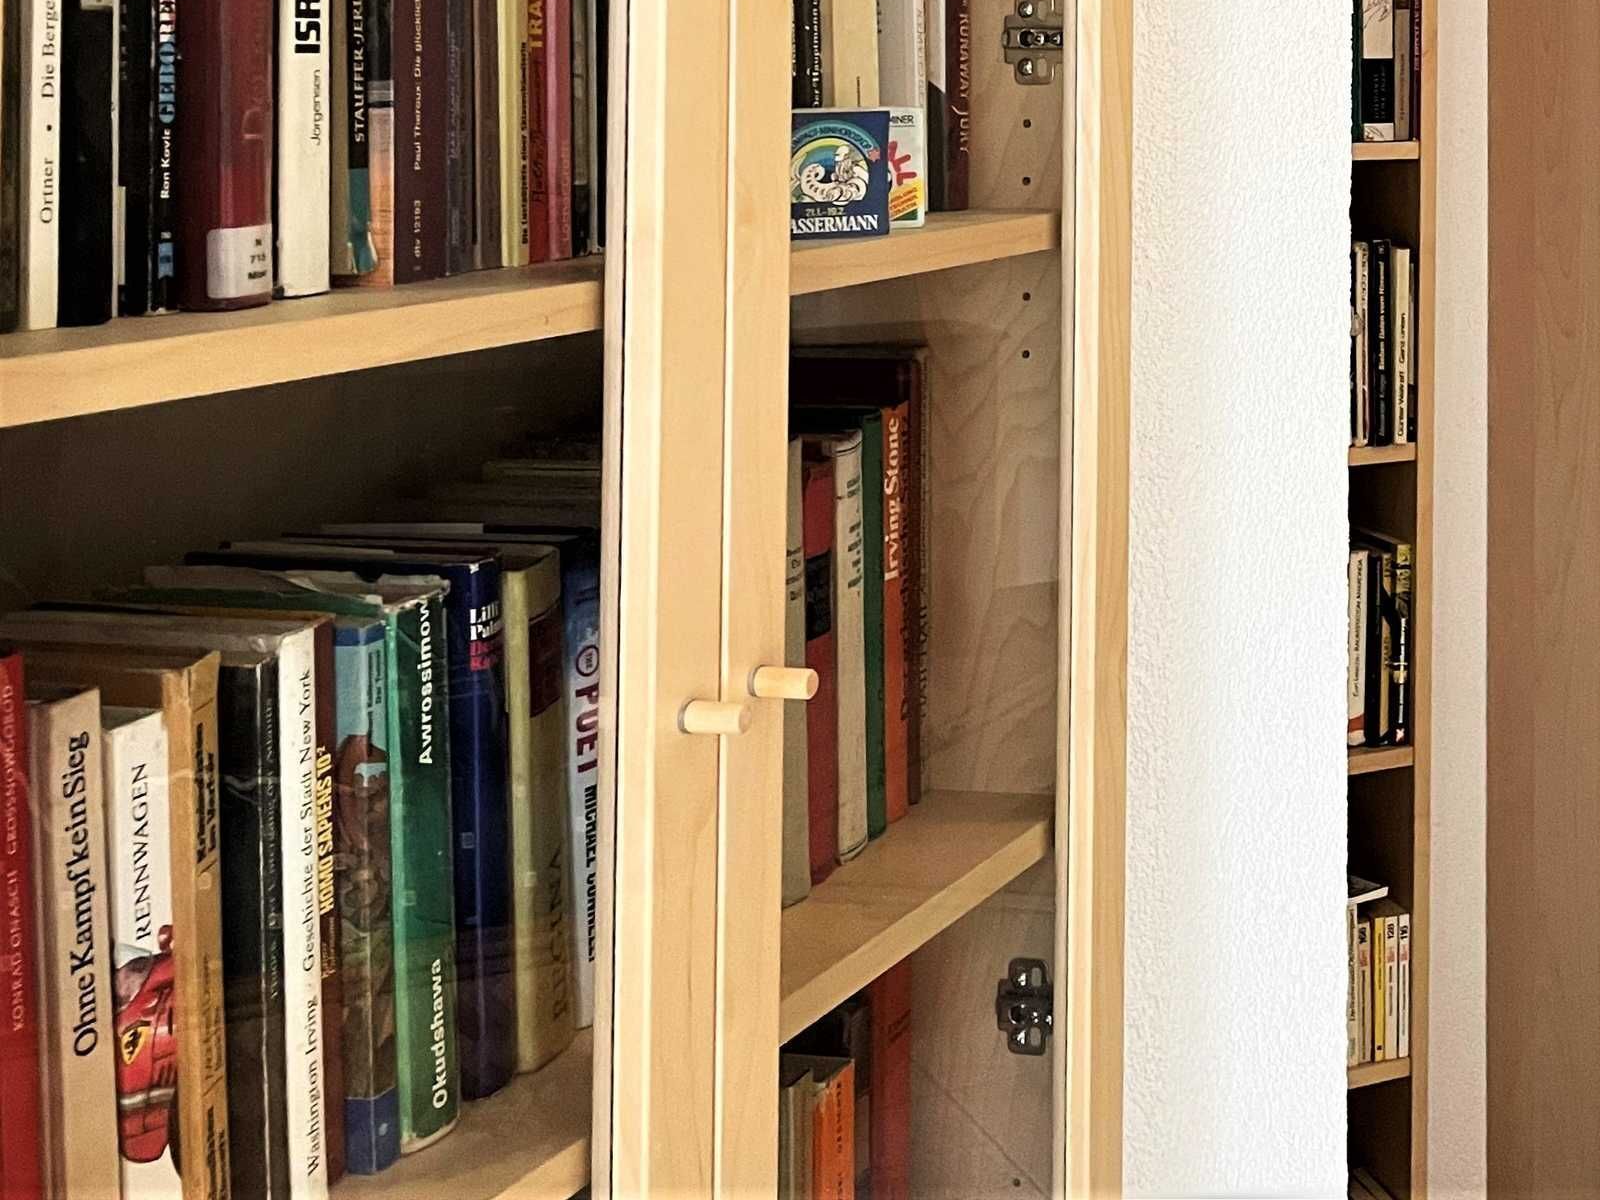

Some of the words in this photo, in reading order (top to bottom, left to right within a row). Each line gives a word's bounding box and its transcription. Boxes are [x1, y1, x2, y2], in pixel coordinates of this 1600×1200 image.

[41, 0, 59, 59] Berge
[811, 8, 822, 85] Hauptmann
[40, 61, 55, 100] Die
[414, 54, 422, 79] Die
[160, 128, 173, 169] Kovic
[414, 142, 422, 171] Paul
[40, 158, 54, 225] Ortner
[160, 172, 172, 199] Ron
[883, 417, 900, 496] Stone
[883, 496, 901, 582] Irving
[298, 670, 312, 717] York
[415, 598, 434, 764] Awrossimow
[2, 684, 18, 856] GROSSNOWGOROD
[61, 729, 91, 798] Sieg
[298, 721, 313, 765] New
[64, 798, 91, 867] kein
[299, 771, 314, 823] Stadt
[317, 778, 335, 854] SAPIENS
[584, 784, 598, 868] MICHAEL
[130, 762, 153, 941] RENNWAGEN
[300, 827, 314, 858] der
[7, 869, 22, 949] ONASCH
[66, 867, 97, 976] Kampf
[300, 863, 316, 974] Geschichte
[319, 855, 335, 916] HOMO
[10, 952, 26, 1032] KONRAD
[73, 972, 99, 1057] Ohne
[304, 998, 319, 1056] Irving
[428, 957, 450, 1109] Okudshawa
[305, 1062, 321, 1177] Washington
